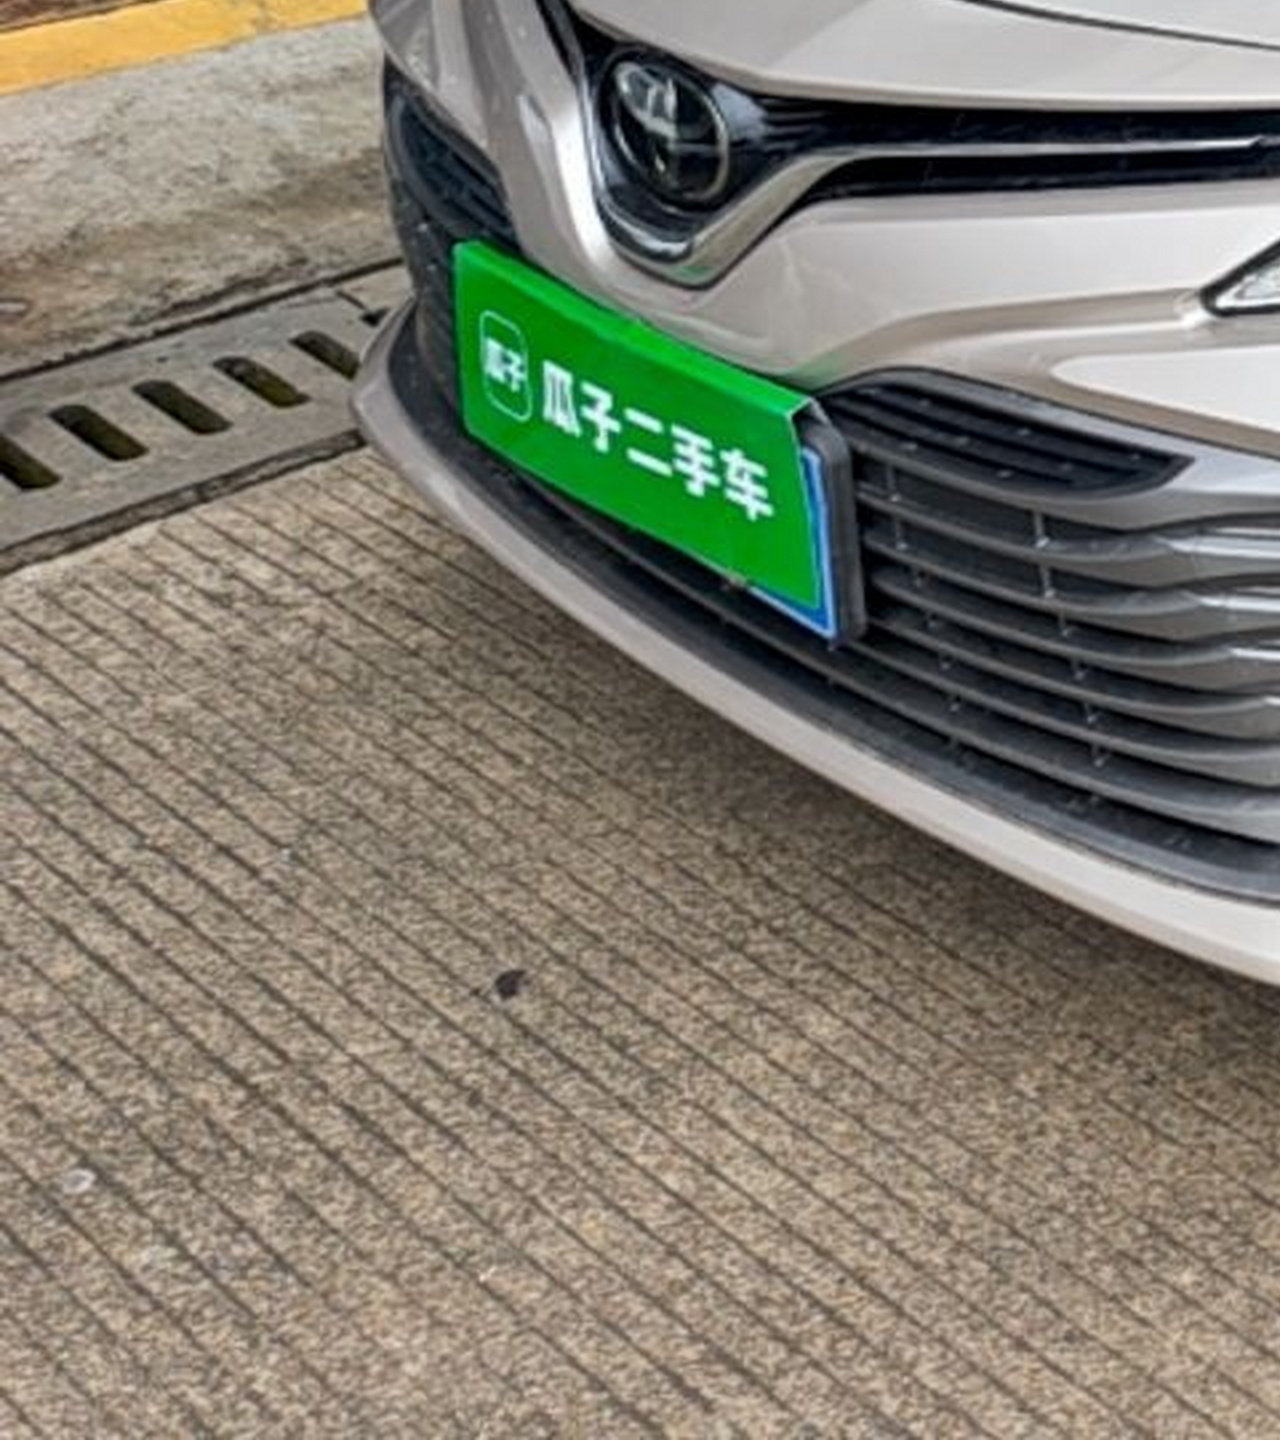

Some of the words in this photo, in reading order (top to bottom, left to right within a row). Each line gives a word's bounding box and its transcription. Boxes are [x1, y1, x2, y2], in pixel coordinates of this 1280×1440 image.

[542, 360, 775, 522] 瓜子二手车
